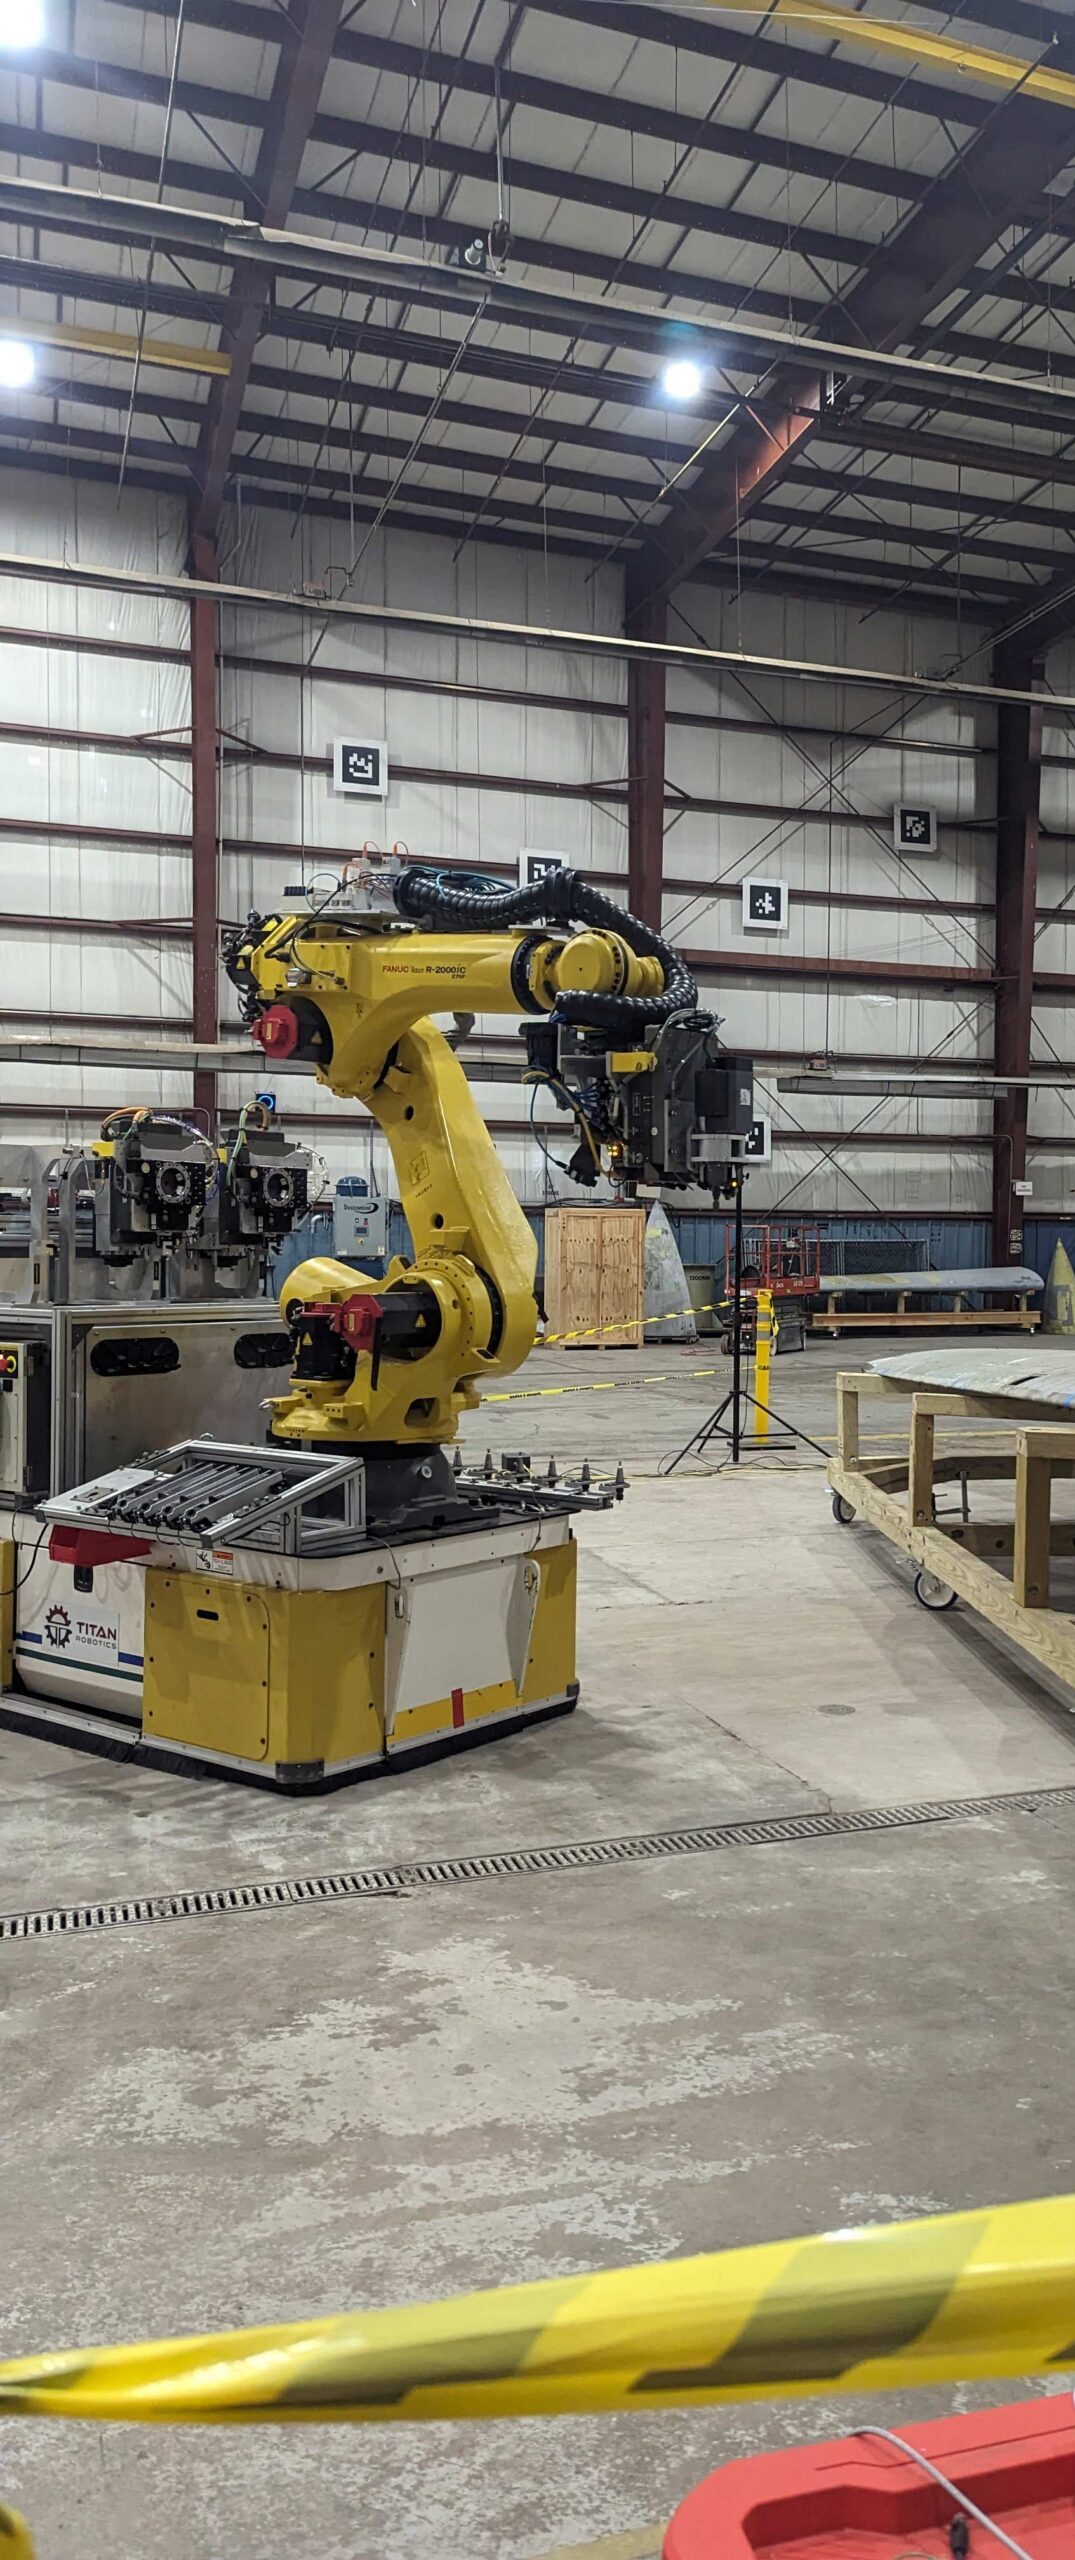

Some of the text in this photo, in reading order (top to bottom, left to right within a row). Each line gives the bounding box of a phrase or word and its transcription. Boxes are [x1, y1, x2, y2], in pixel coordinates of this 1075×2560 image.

[382, 965, 409, 973] FANUC
[426, 963, 466, 973] R-2000iC
[76, 1621, 117, 1640] TITAN
[75, 1636, 117, 1649] ROBOTICS
